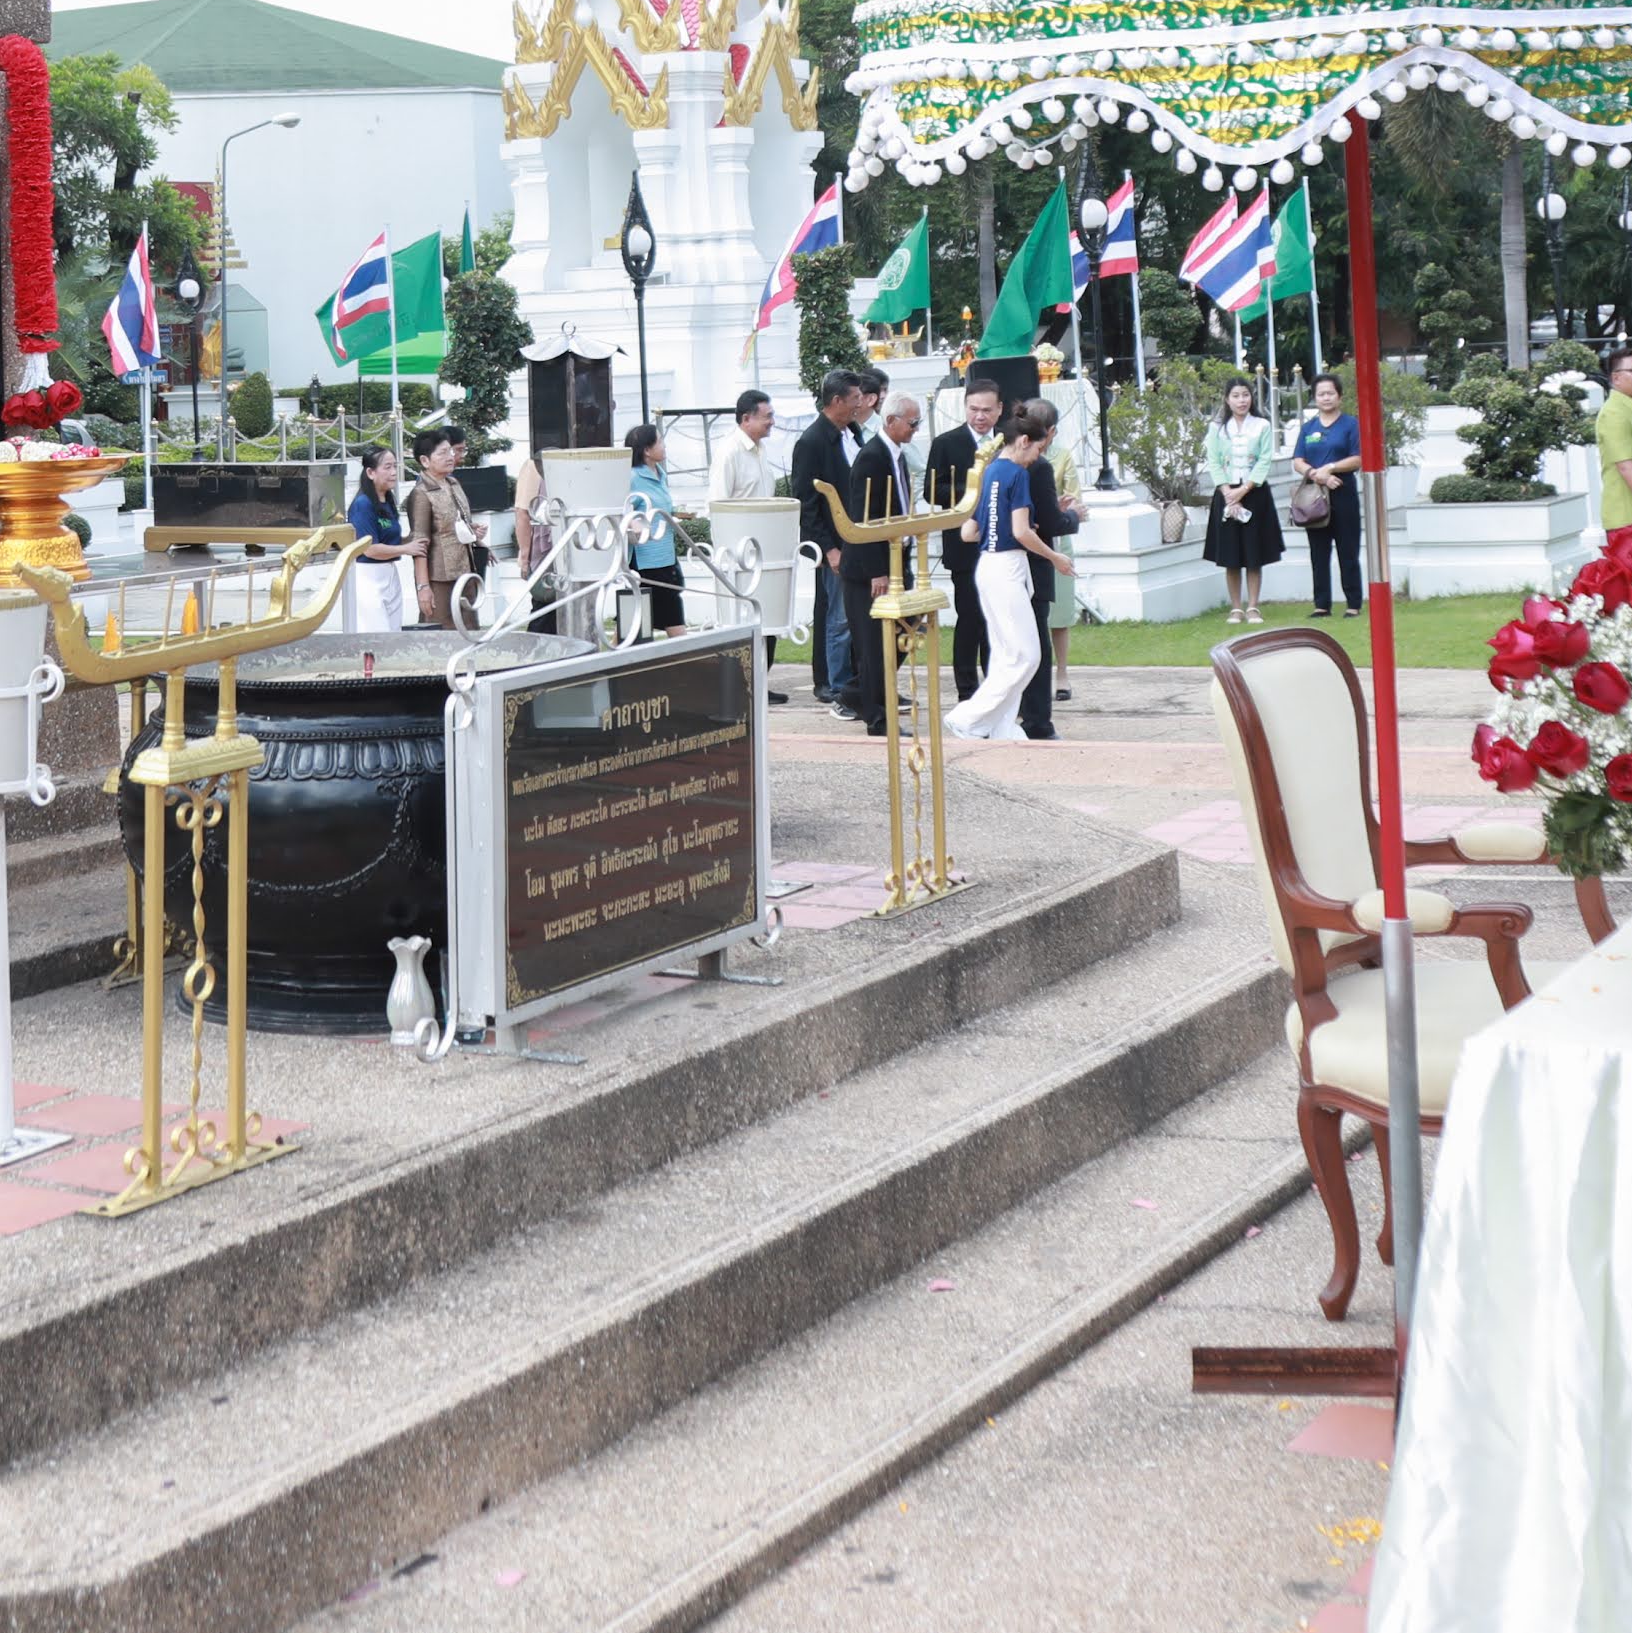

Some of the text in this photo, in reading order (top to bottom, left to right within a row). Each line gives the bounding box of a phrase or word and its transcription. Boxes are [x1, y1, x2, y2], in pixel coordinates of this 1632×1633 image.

[602, 695, 670, 734] คาถาบูชา
[526, 868, 546, 899] โอม
